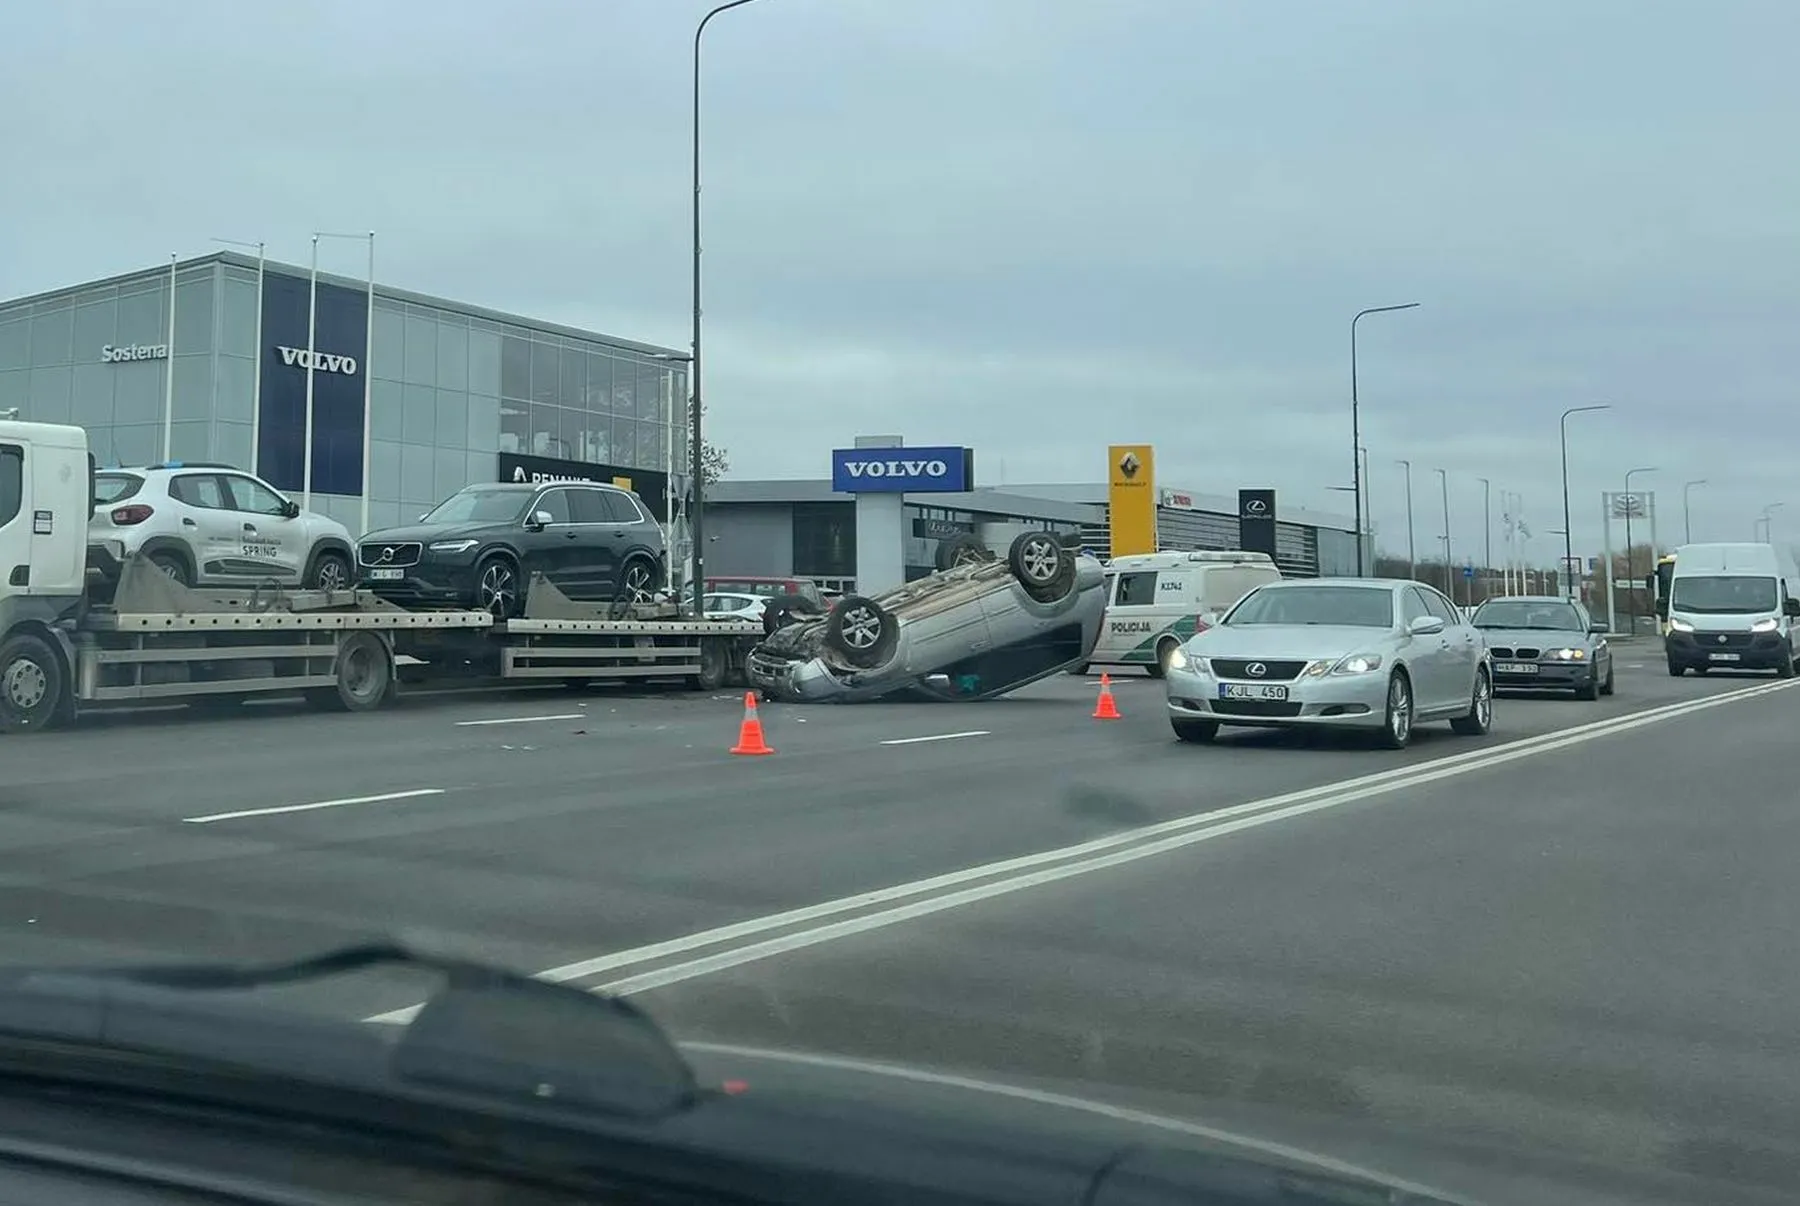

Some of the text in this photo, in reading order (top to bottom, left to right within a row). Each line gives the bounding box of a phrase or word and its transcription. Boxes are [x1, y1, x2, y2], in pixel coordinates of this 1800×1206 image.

[102, 344, 168, 362] Sostena
[276, 346, 357, 375] VOLVO
[844, 460, 947, 477] VOLVO
[242, 545, 278, 558] SPRING
[1111, 621, 1152, 632] POLICIJA
[1227, 685, 1284, 698] KJL 450
